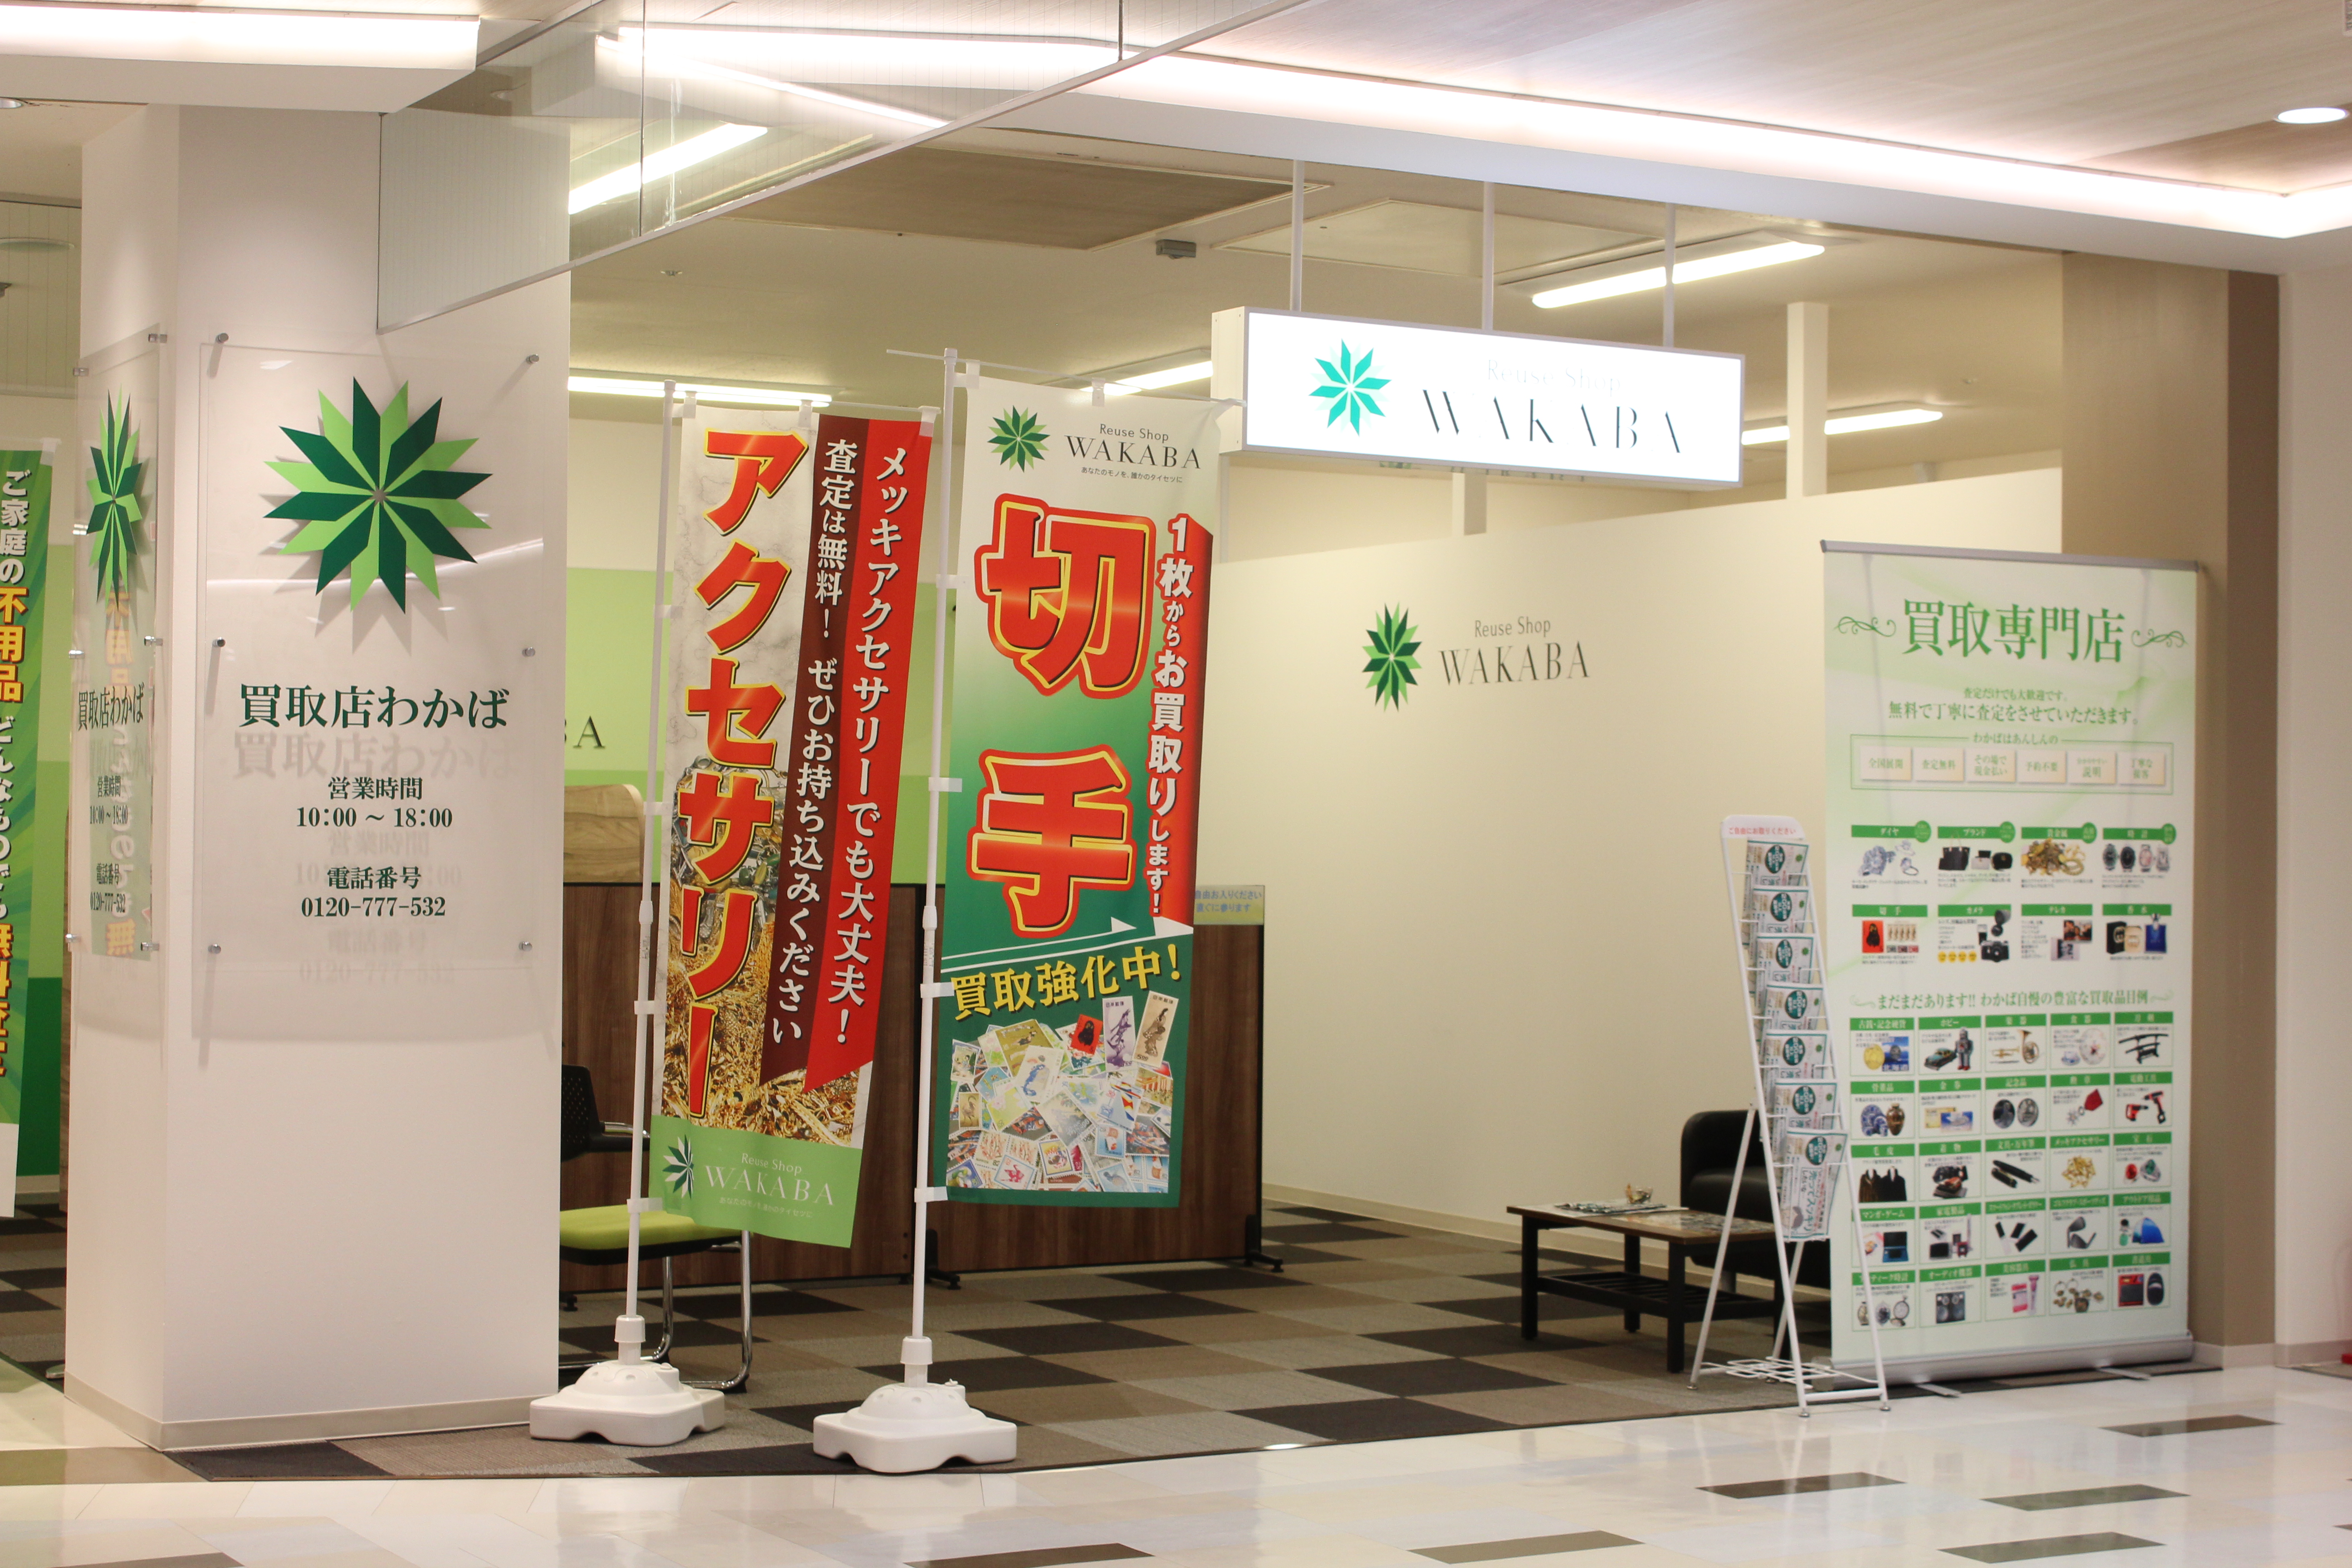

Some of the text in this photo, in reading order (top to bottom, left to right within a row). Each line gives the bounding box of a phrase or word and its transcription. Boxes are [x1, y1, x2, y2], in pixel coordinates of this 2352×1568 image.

[1099, 423, 1169, 444] Reuse Shop
[1422, 389, 1681, 454] WAKABA
[1064, 435, 1201, 470] WAKABA
[1474, 616, 1551, 637] Reuse Shop
[1902, 598, 2126, 663] 買取専門店
[1438, 640, 1591, 686] WAKABA
[78, 681, 145, 731] 買取店わかば
[238, 683, 510, 729] 買取店わかば
[971, 498, 1152, 933] 切手
[97, 775, 122, 799] 営業時間
[327, 776, 424, 801] 営業時間
[677, 429, 808, 1119] アクセサリー
[96, 862, 120, 885] 電話番号
[327, 866, 422, 890] 電話番号
[89, 892, 126, 914] 0120-777-532
[301, 897, 446, 918] 0120-777-532
[742, 1153, 802, 1176] Reuse Shop
[705, 1165, 833, 1205] WAKABA
